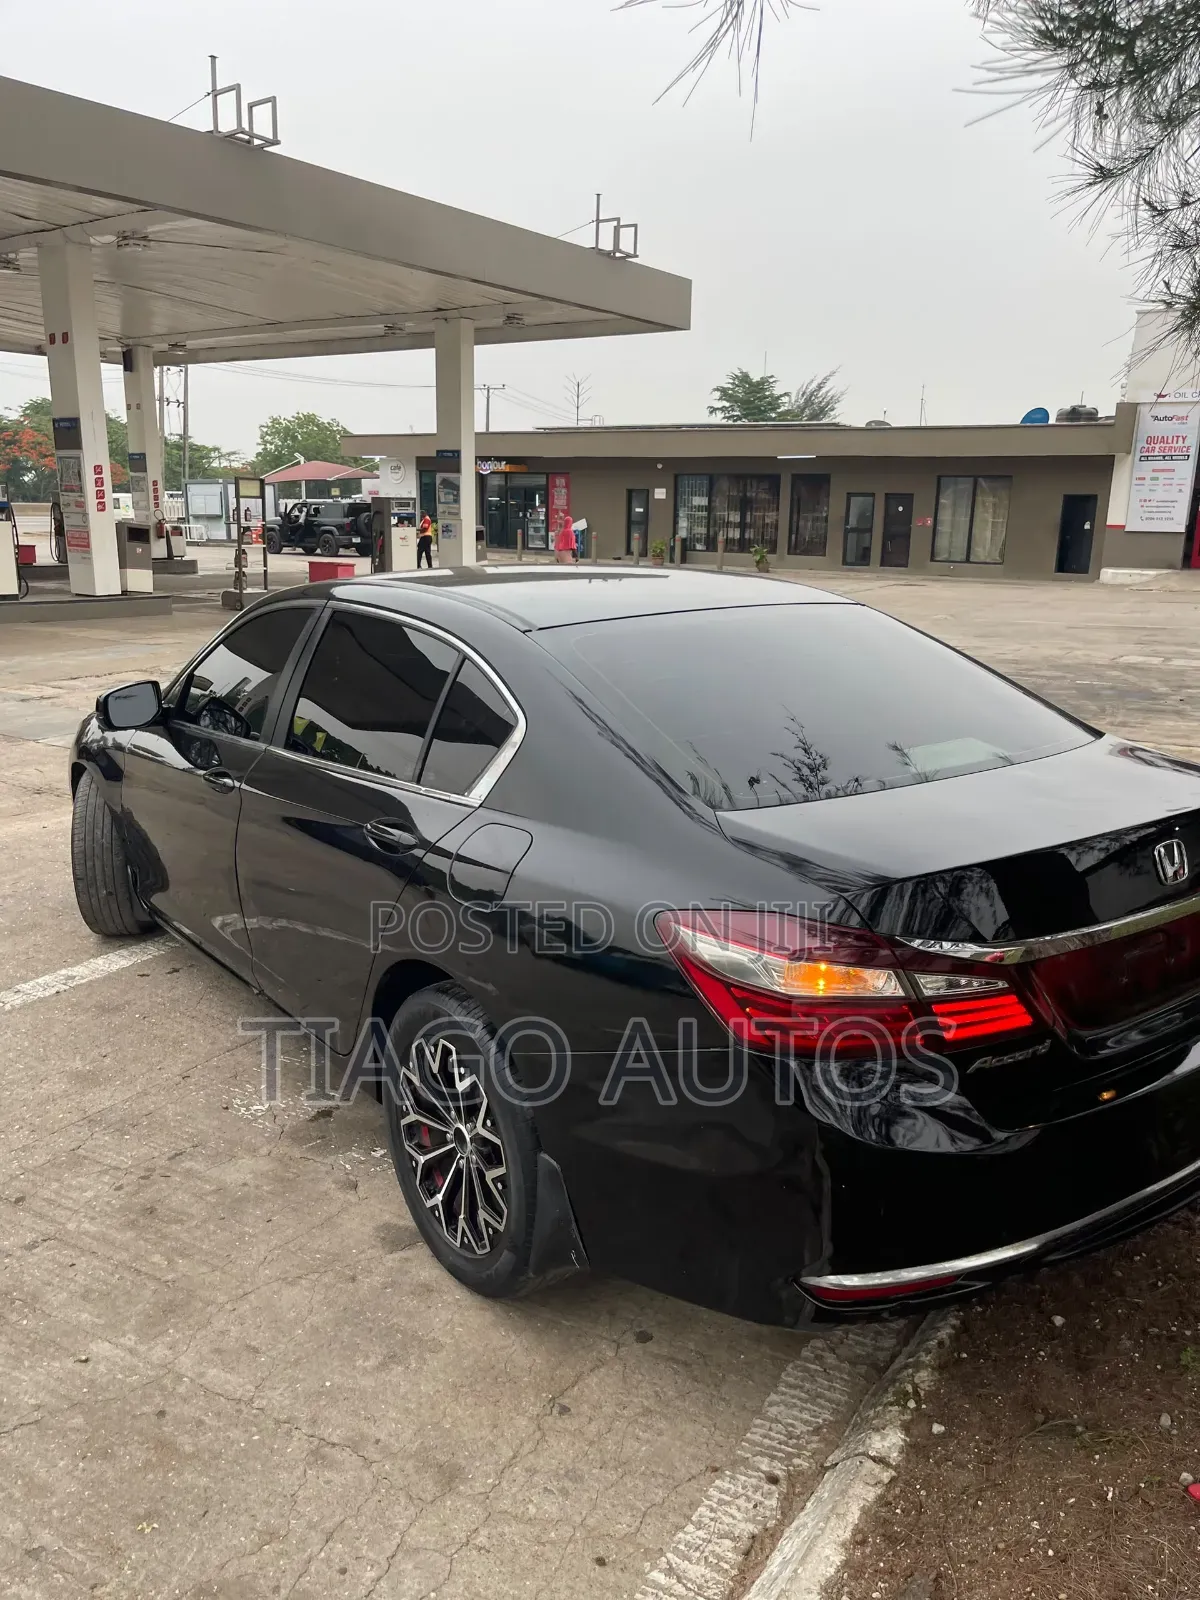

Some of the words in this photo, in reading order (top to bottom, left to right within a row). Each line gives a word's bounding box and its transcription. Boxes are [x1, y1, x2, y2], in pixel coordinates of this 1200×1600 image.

[1173, 391, 1189, 399] OIL
[1145, 435, 1188, 445] QUALITY
[1139, 446, 1157, 454] CAR
[1157, 445, 1192, 454] SERVICE
[476, 457, 506, 472] bonjour
